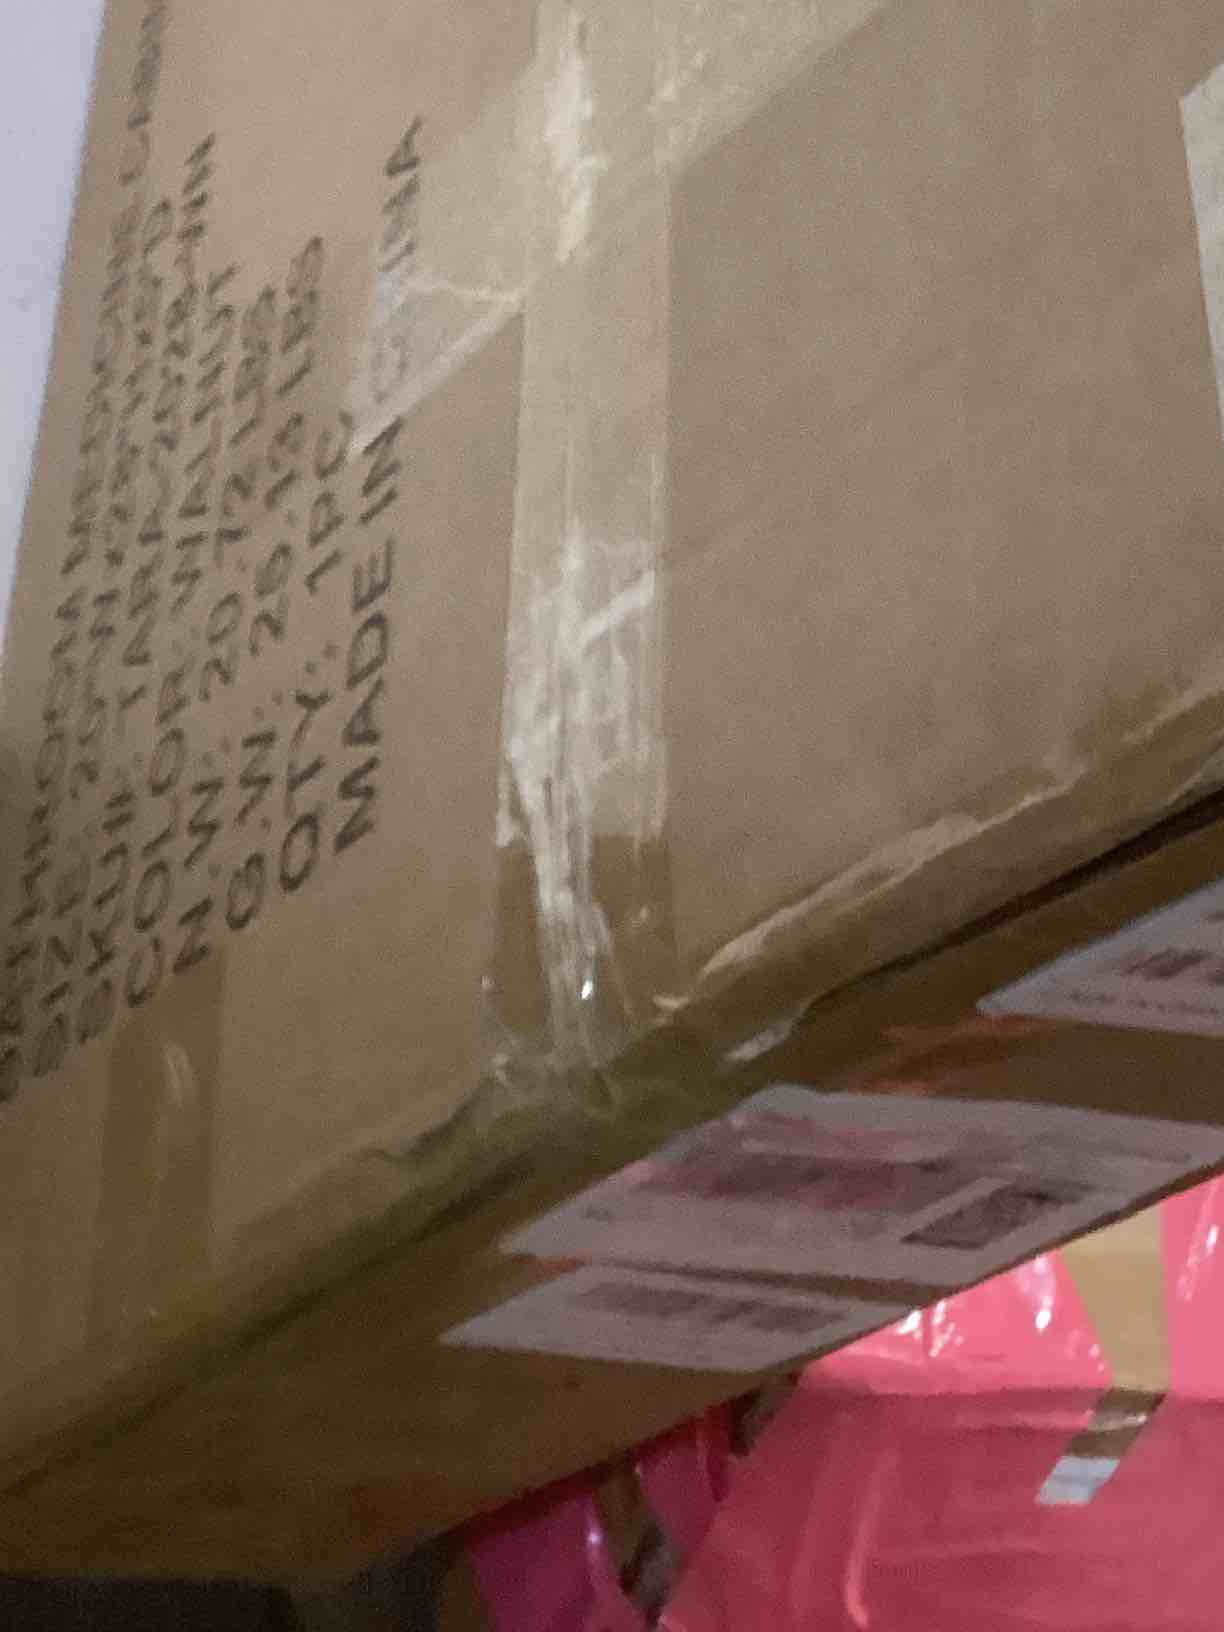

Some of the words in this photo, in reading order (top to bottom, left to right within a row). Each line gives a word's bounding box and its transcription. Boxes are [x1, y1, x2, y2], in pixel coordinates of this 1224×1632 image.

[276, 234, 323, 401] LBS
[367, 115, 423, 405] CINA
[168, 258, 240, 618] WALNUT
[302, 406, 354, 598] 1PC
[357, 416, 402, 530] IN
[334, 535, 394, 856] MADE
